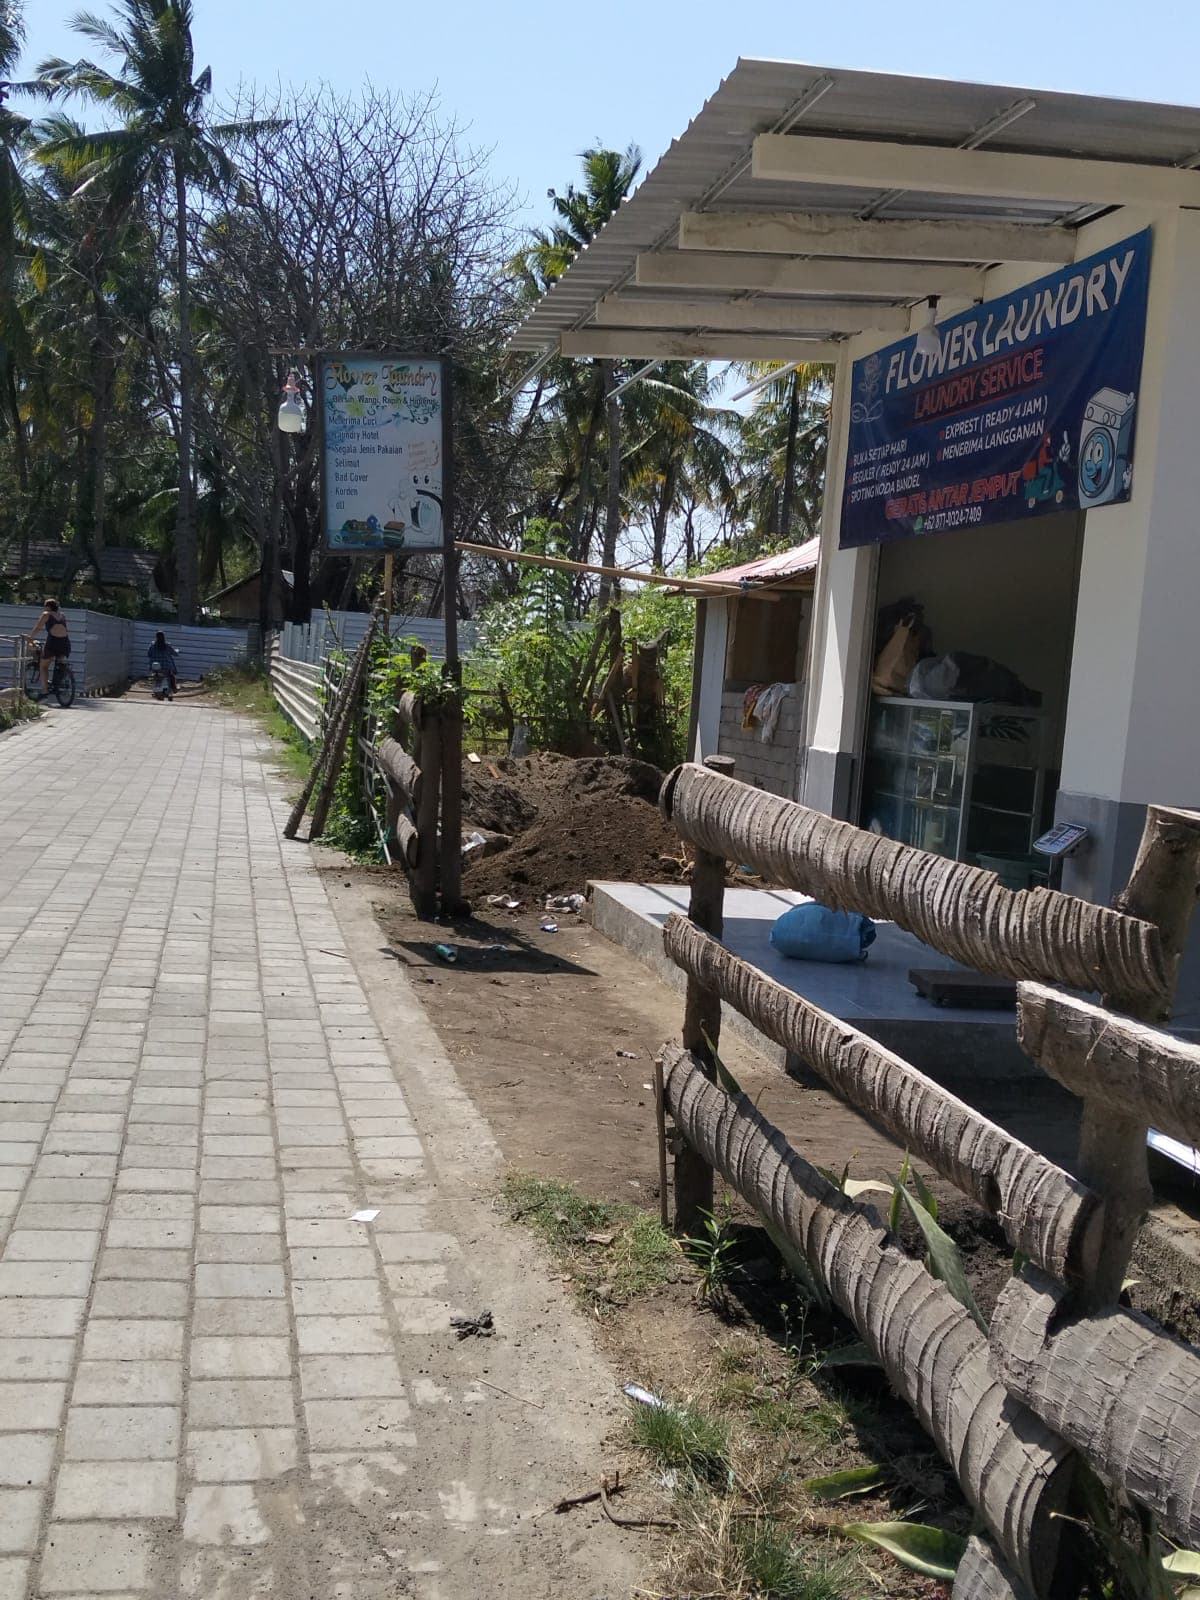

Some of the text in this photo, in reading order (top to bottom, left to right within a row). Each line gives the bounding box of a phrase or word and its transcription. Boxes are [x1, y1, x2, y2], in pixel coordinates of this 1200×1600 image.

[885, 249, 1135, 394] FLOWER LAUNDRY
[381, 365, 437, 396] Laundry
[914, 349, 1045, 419] LAUNDRY SERVICE
[945, 416, 980, 440] EXPREST
[985, 405, 1015, 428] READY
[1014, 403, 1021, 419] 4
[1021, 396, 1042, 417] JAM
[362, 430, 379, 440] Hotel
[942, 419, 1045, 461] MENERIMA LANGGANAN
[335, 444, 403, 455] Segala Jenis Pakaian
[335, 458, 360, 468] Selimut
[349, 472, 368, 482] Cover
[896, 474, 920, 493] BANDEL
